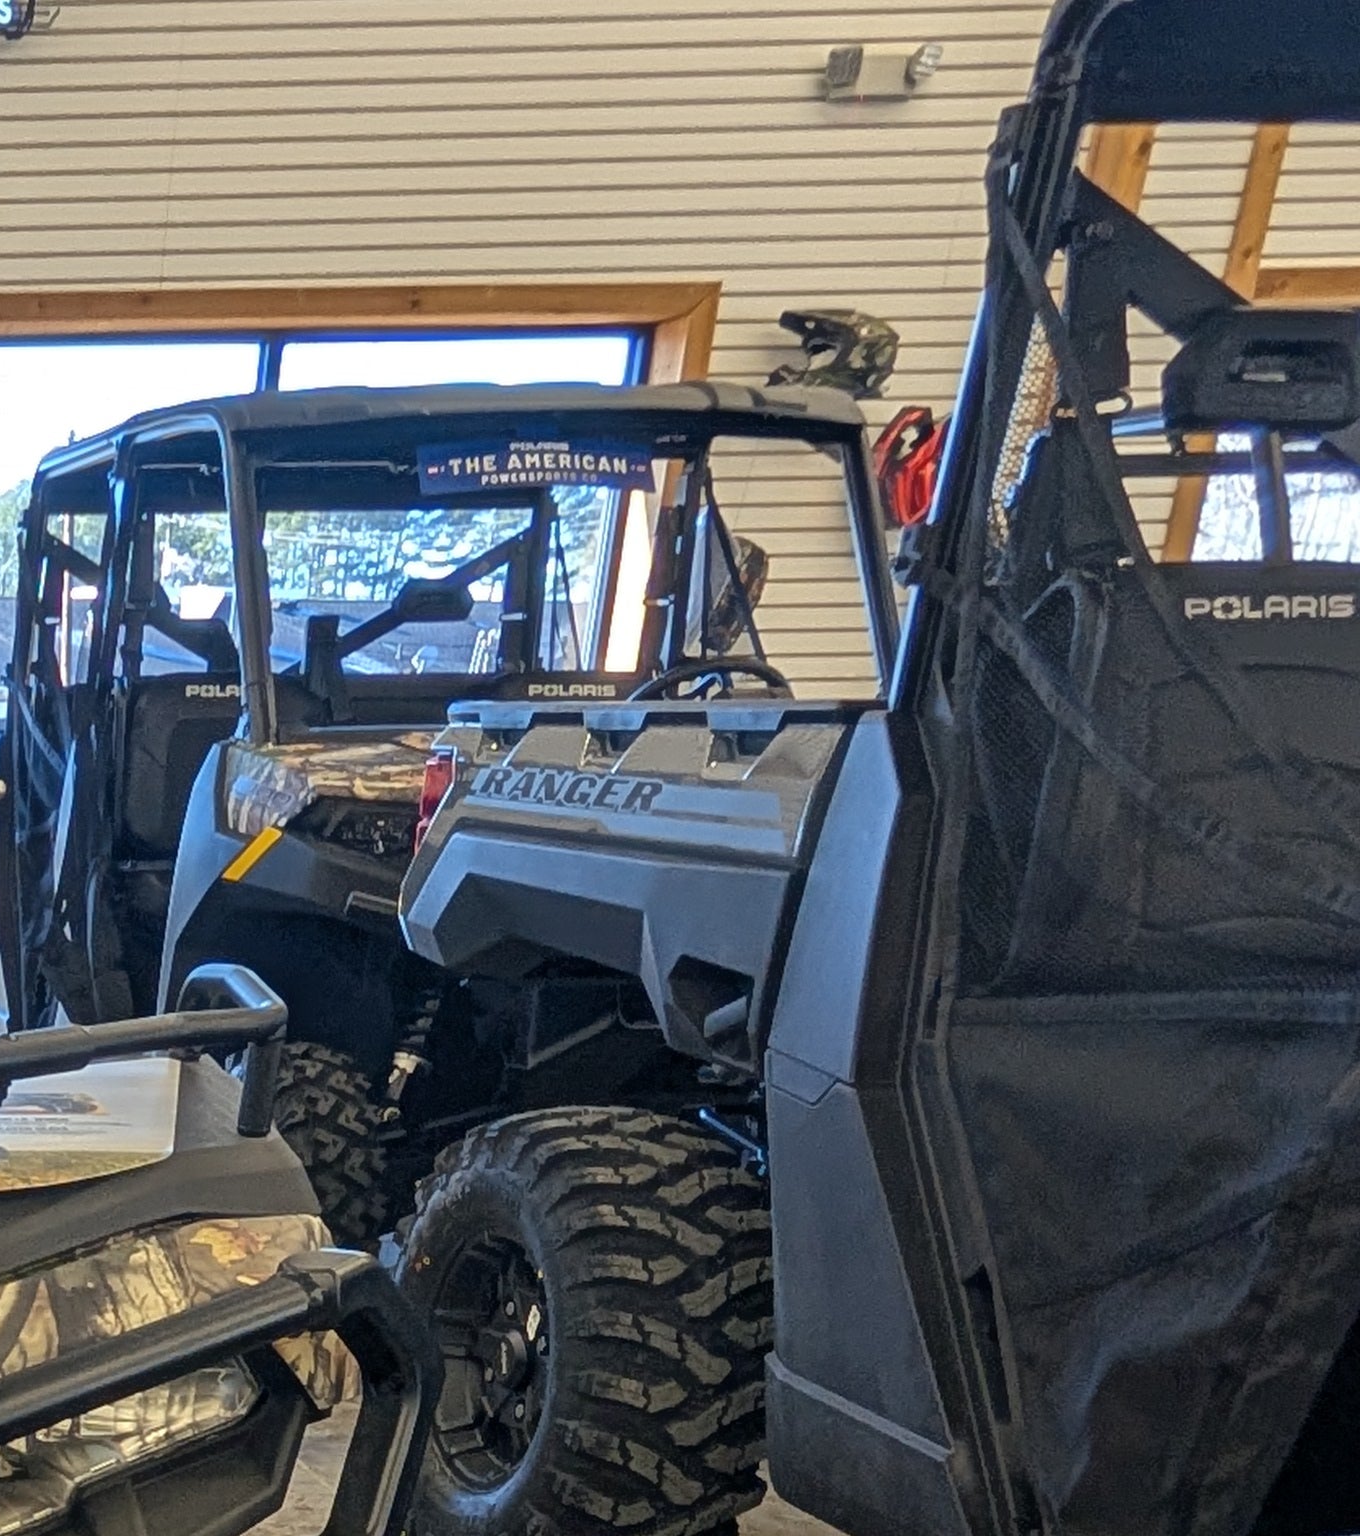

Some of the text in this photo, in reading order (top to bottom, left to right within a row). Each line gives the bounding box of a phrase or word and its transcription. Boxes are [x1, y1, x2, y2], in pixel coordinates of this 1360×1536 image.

[449, 453, 627, 475] THE AMERICAN
[481, 471, 577, 485] POWERSPORTS
[1184, 594, 1355, 620] POLARIS
[185, 684, 240, 698] POLA
[528, 684, 616, 697] POLARIS
[479, 767, 664, 814] RANGER
